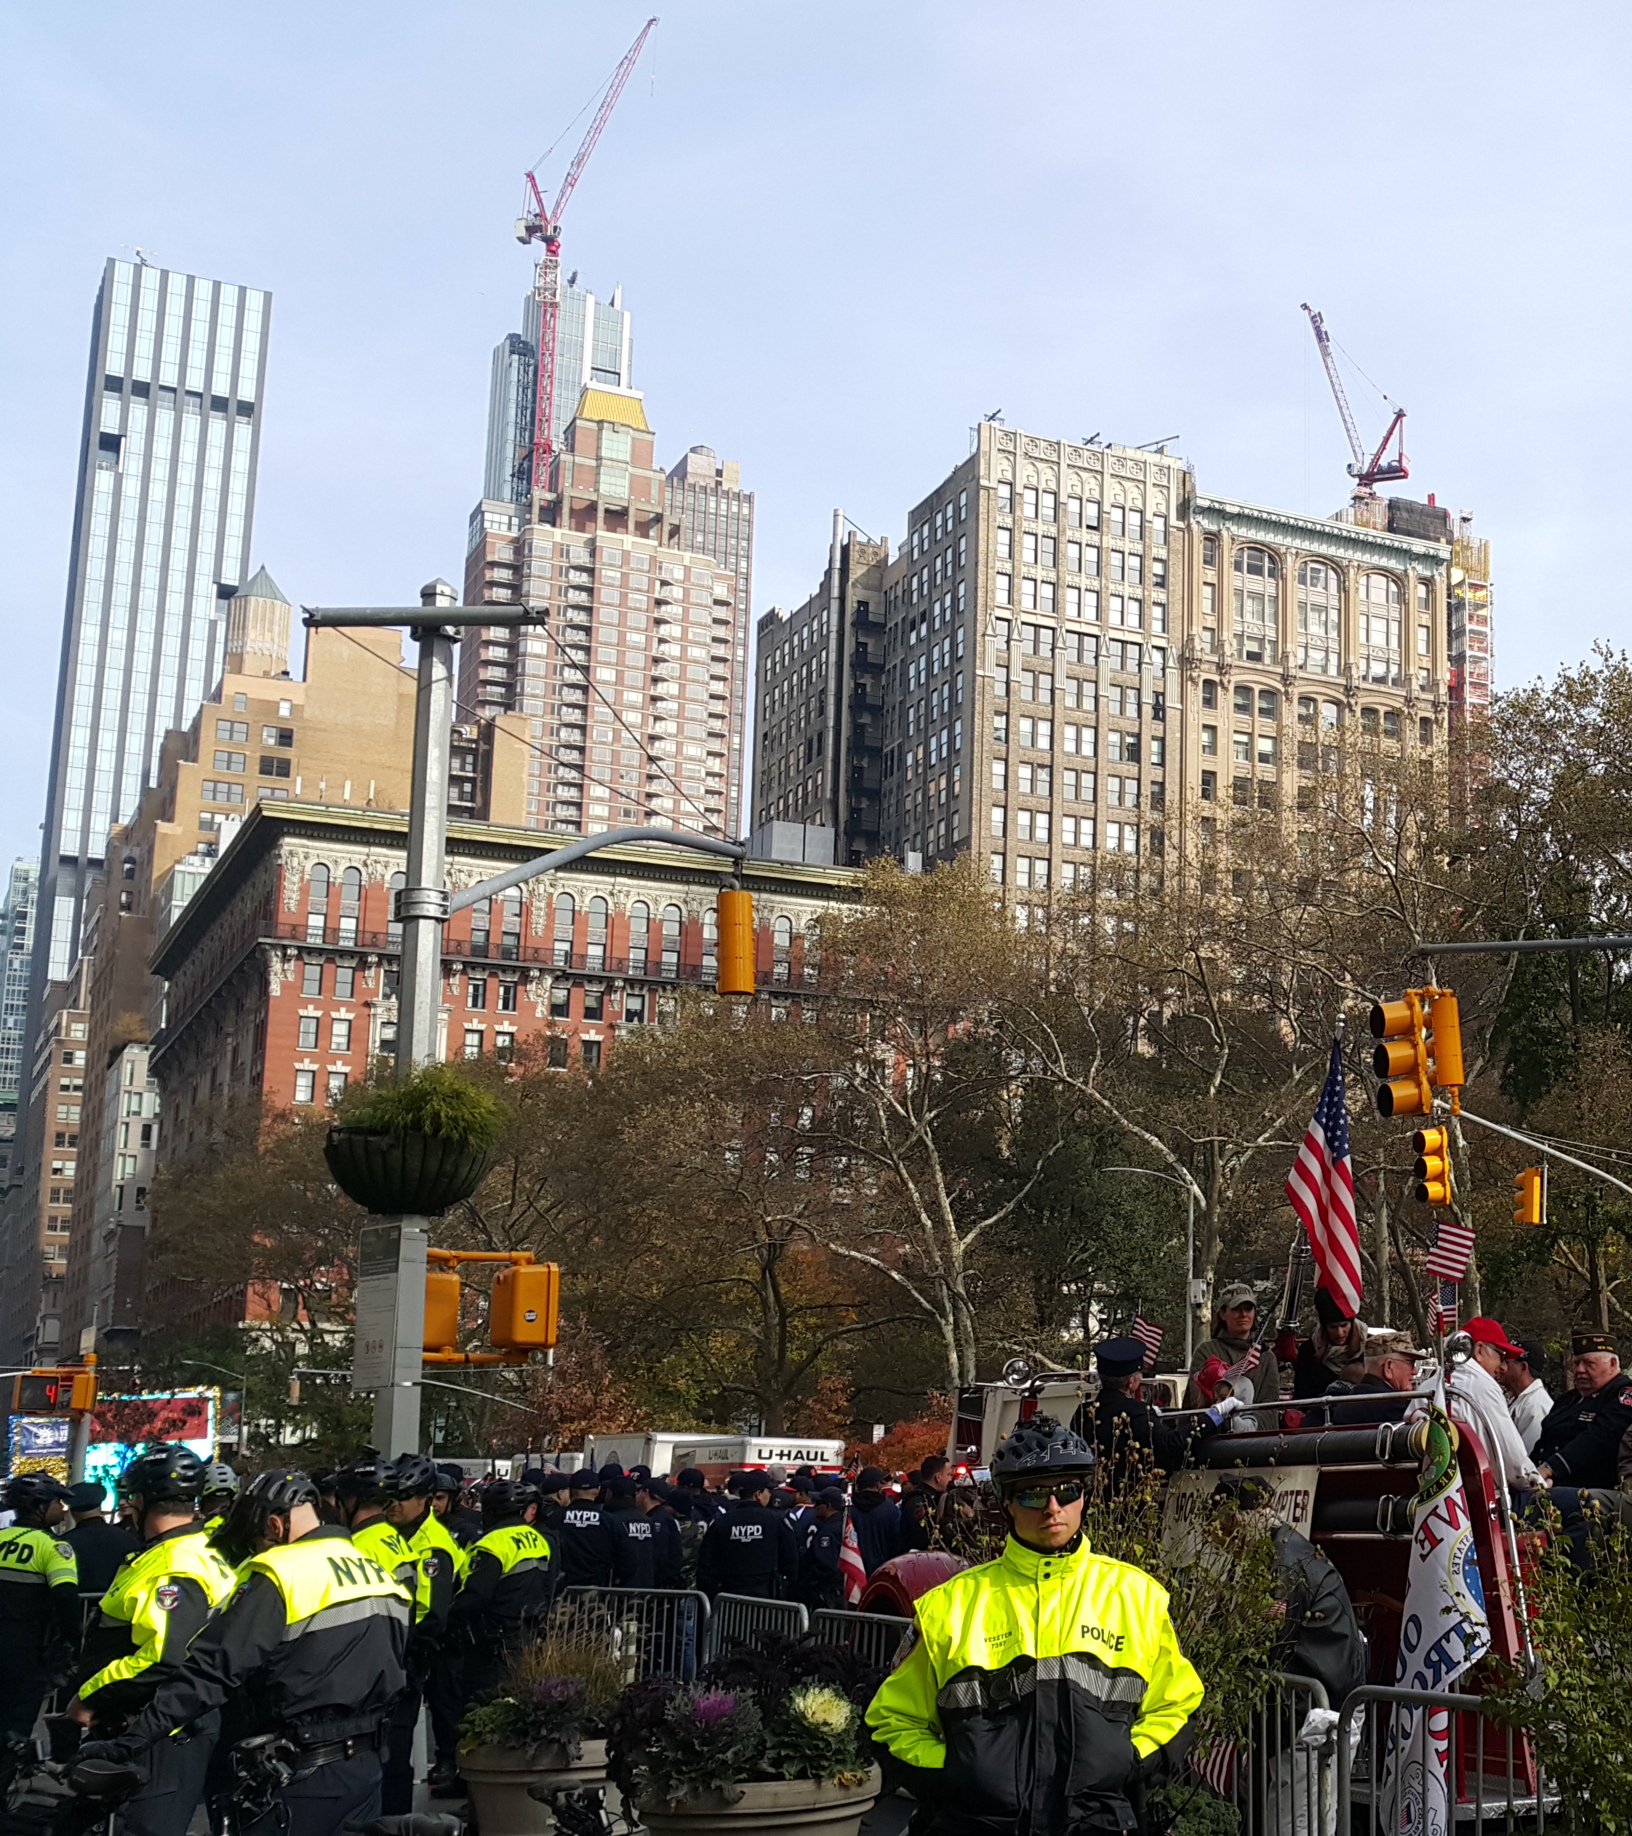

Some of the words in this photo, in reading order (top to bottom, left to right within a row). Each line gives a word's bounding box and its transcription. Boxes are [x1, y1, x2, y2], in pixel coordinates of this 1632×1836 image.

[45, 1384, 57, 1404] 4
[757, 1448, 829, 1462] U-HAUL
[565, 1510, 600, 1522] NYPD
[629, 1522, 651, 1535] NYPD
[731, 1525, 763, 1537] NYPD
[510, 1530, 539, 1551] NYP
[327, 1556, 386, 1588] NYP
[1080, 1624, 1125, 1652] POLICE
